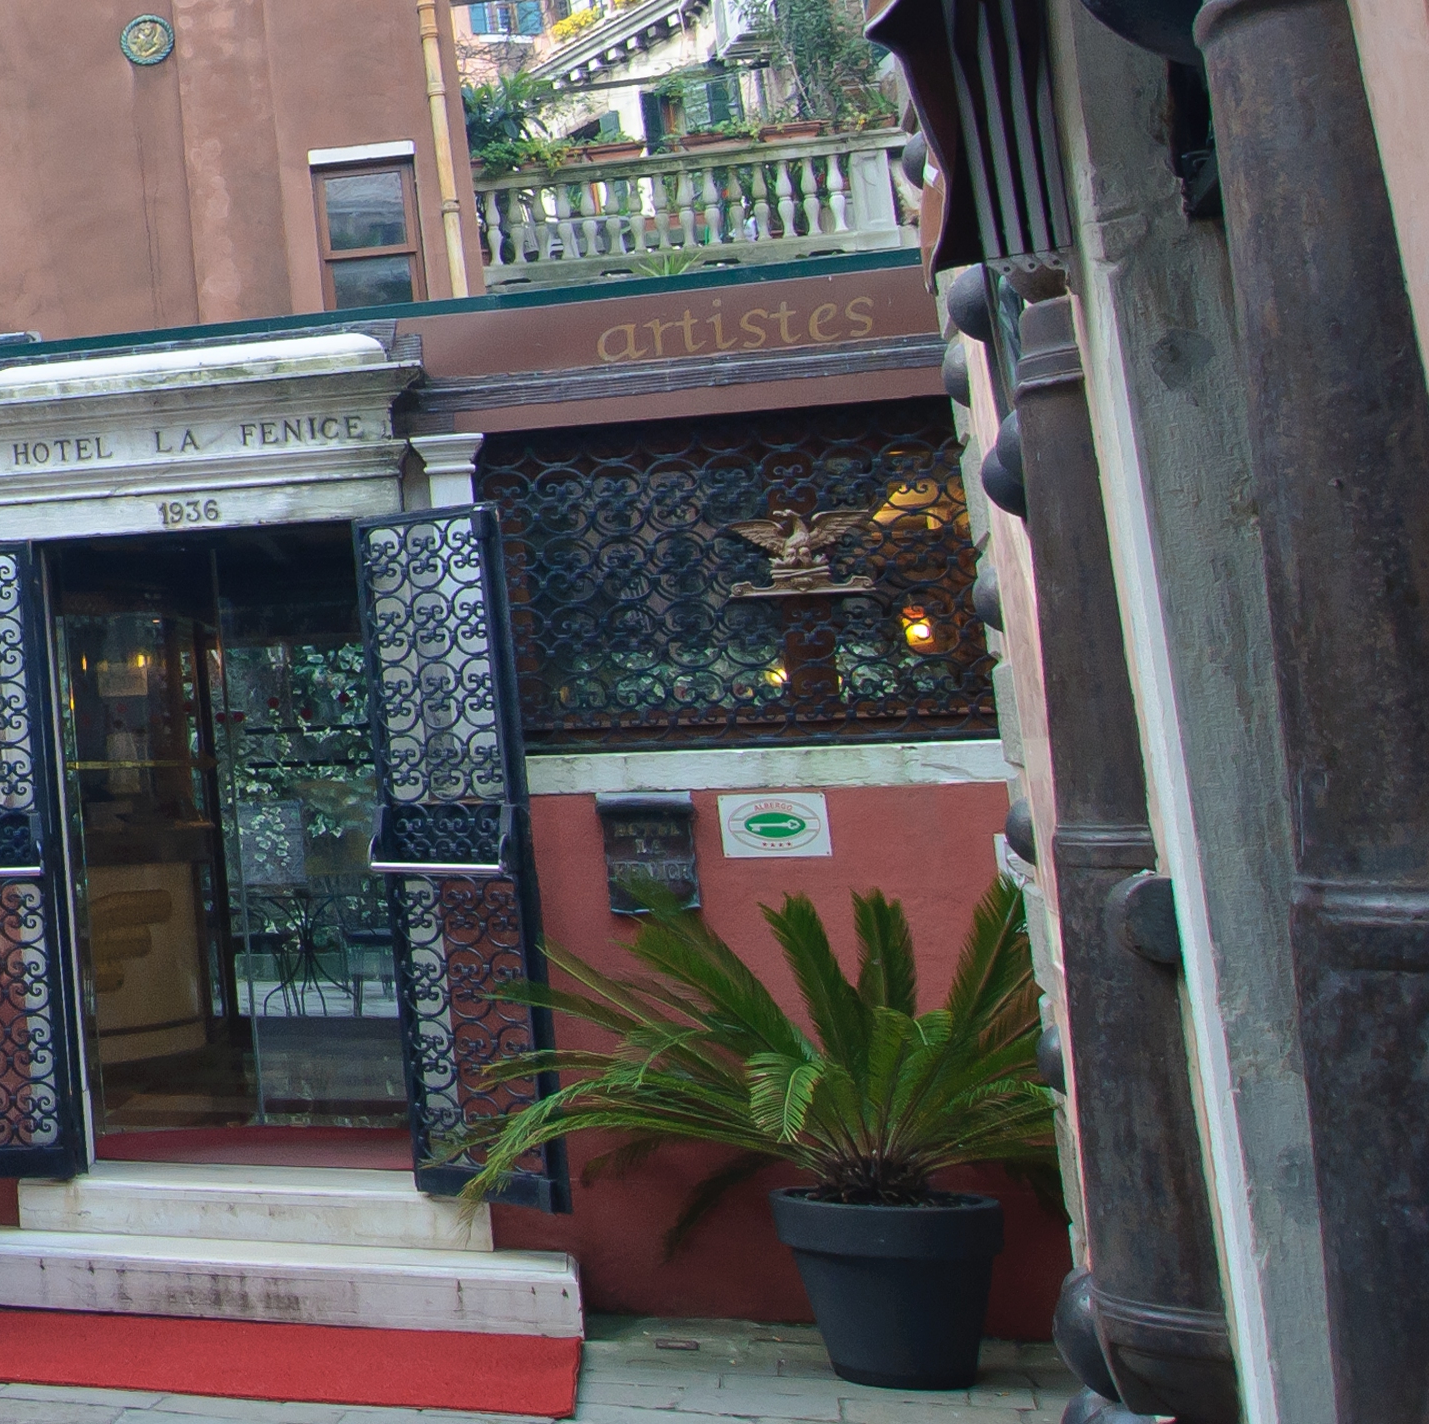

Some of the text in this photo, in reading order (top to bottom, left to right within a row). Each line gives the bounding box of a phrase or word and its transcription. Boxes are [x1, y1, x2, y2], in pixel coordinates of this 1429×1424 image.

[596, 294, 876, 362] artistes
[12, 414, 365, 467] HOTEL LA FENICE
[158, 498, 221, 526] 1936
[753, 801, 794, 812] ALBERGO
